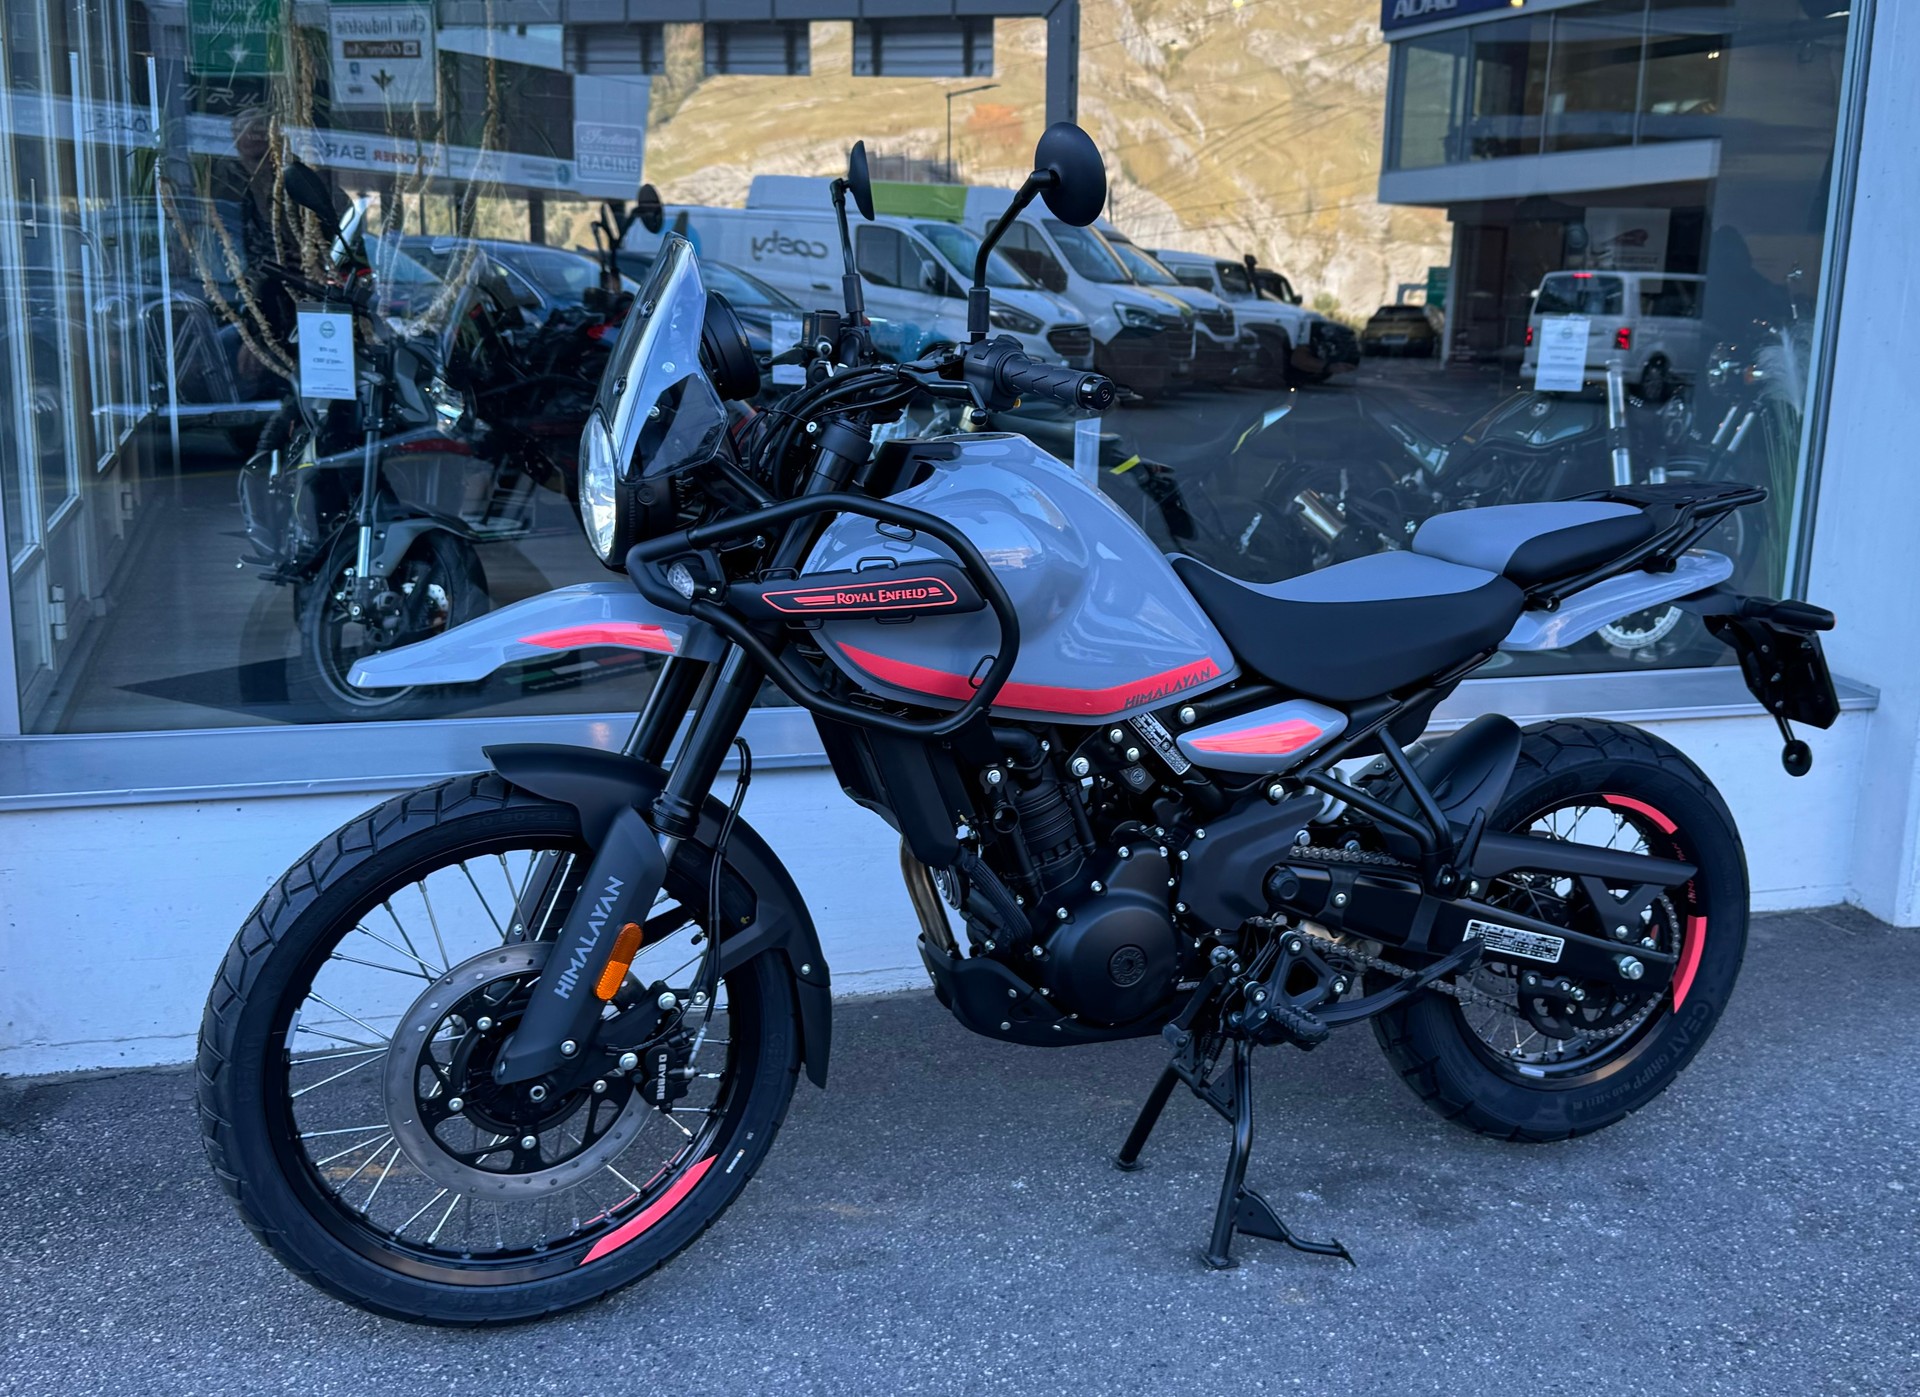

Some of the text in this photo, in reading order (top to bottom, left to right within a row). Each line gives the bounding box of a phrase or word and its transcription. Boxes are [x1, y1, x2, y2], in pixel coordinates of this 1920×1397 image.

[579, 154, 639, 172] RACING
[837, 588, 928, 604] ROYAL ENFIELD
[1123, 666, 1211, 709] HIMALAYAN
[553, 875, 625, 1000] HIMALAYAN
[1667, 1002, 1709, 1058] CEAT
[656, 1063, 668, 1100] BYBRE
[1633, 1053, 1670, 1090] GRIPP
